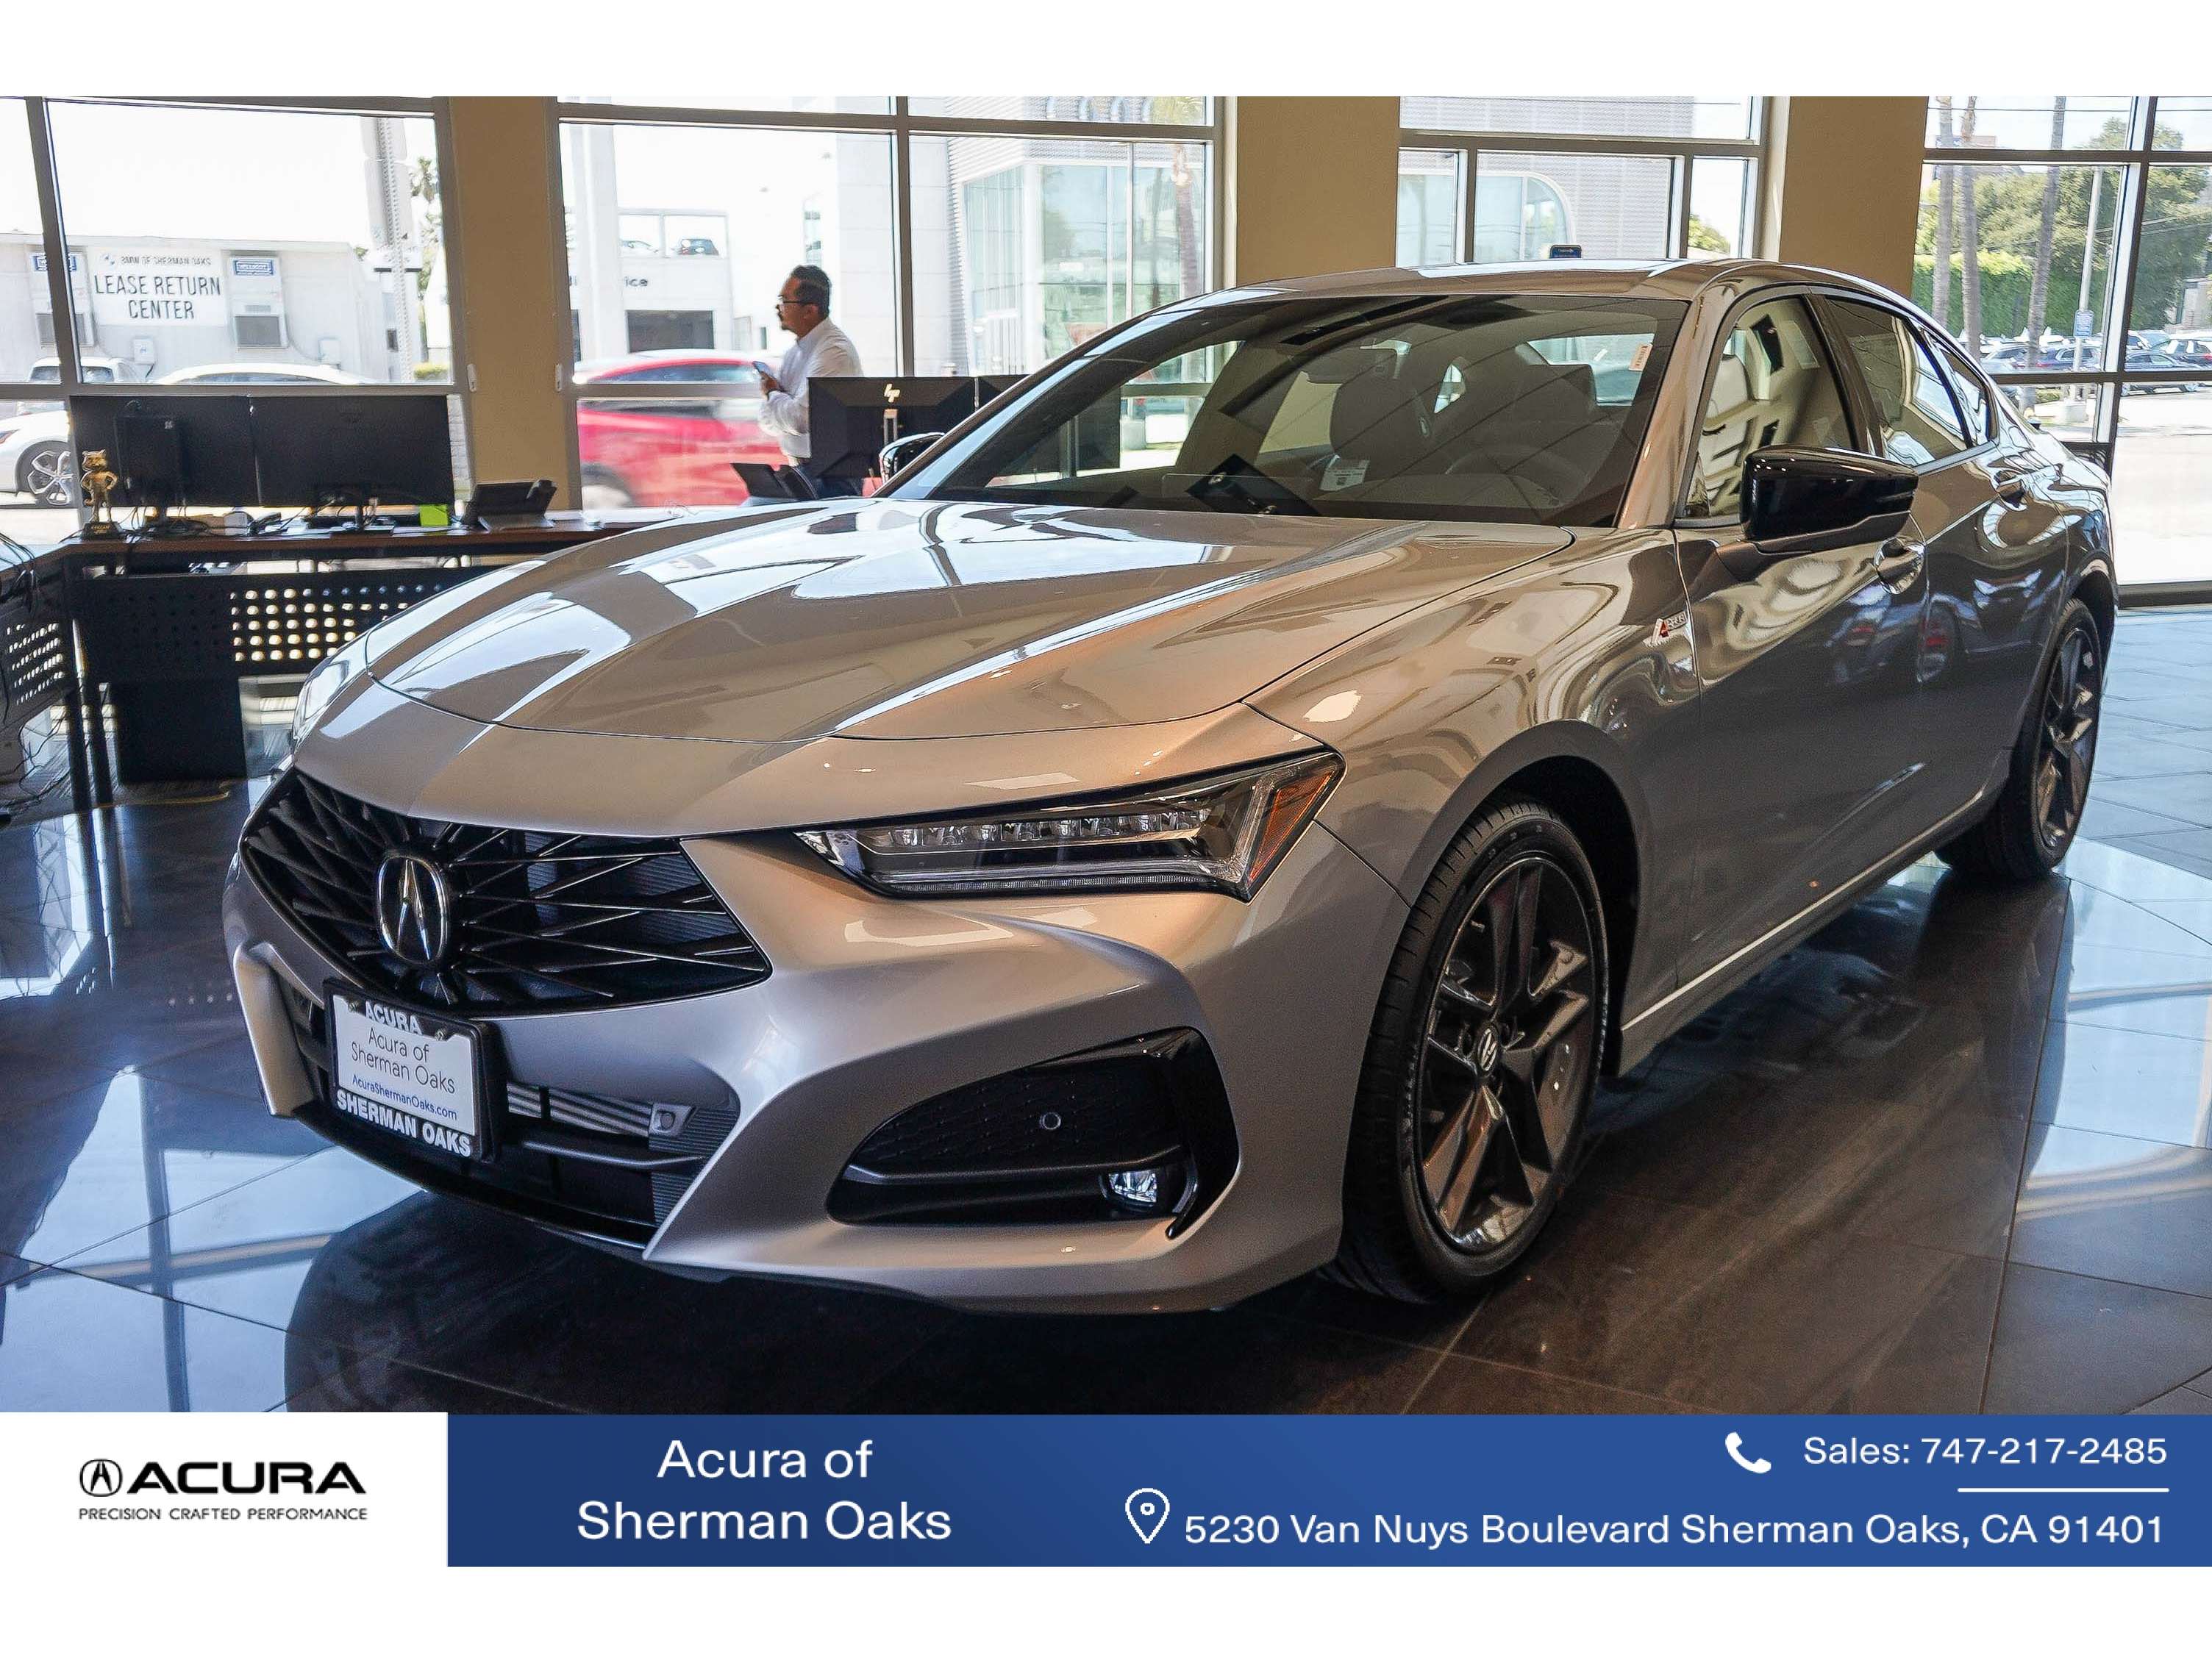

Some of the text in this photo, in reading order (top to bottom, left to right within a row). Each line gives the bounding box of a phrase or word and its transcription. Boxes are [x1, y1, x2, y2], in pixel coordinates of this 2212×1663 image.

[94, 275, 221, 295] LEASE RETURN
[129, 299, 195, 319] CENTER
[365, 1001, 423, 1035] ACURA
[368, 1027, 429, 1063] Acura of
[352, 1042, 456, 1095] Sherman Oaks
[352, 1074, 457, 1121] AcuraShermanOaks.com
[337, 1089, 472, 1157] SHERMAN OAKS
